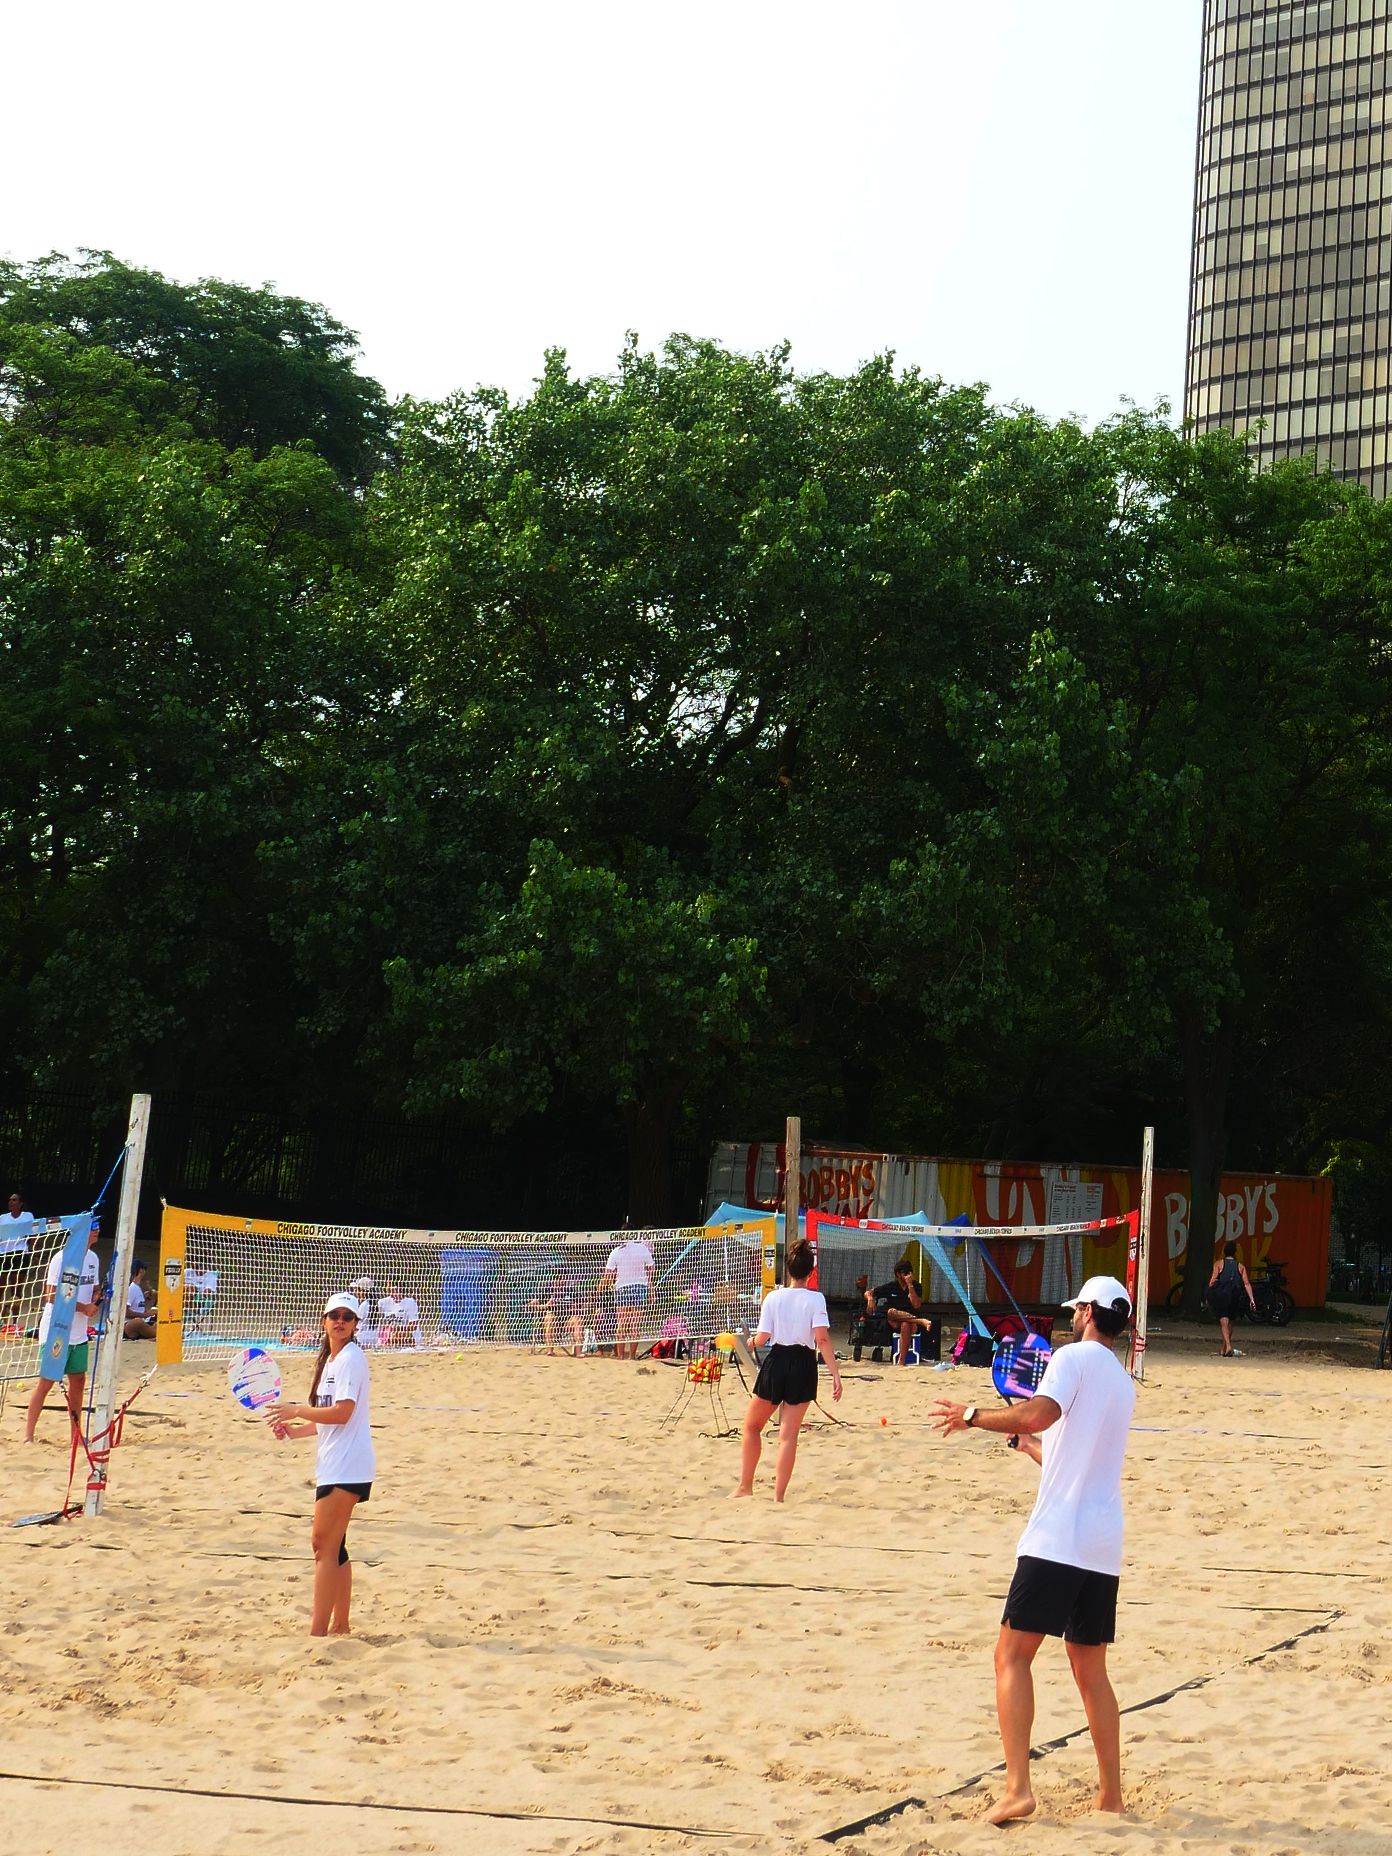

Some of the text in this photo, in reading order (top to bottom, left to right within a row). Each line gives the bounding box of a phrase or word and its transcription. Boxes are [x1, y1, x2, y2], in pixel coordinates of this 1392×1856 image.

[1165, 1180, 1279, 1259] BBBY'S
[277, 1222, 408, 1240] CHICAGO FOOTVOLLEY ACADEMY
[455, 1232, 568, 1243] CHICAGO FOOTVOLLEY ACADEMY
[609, 1227, 707, 1242] CHICAGO FOOTVOLLEY ACADEMY
